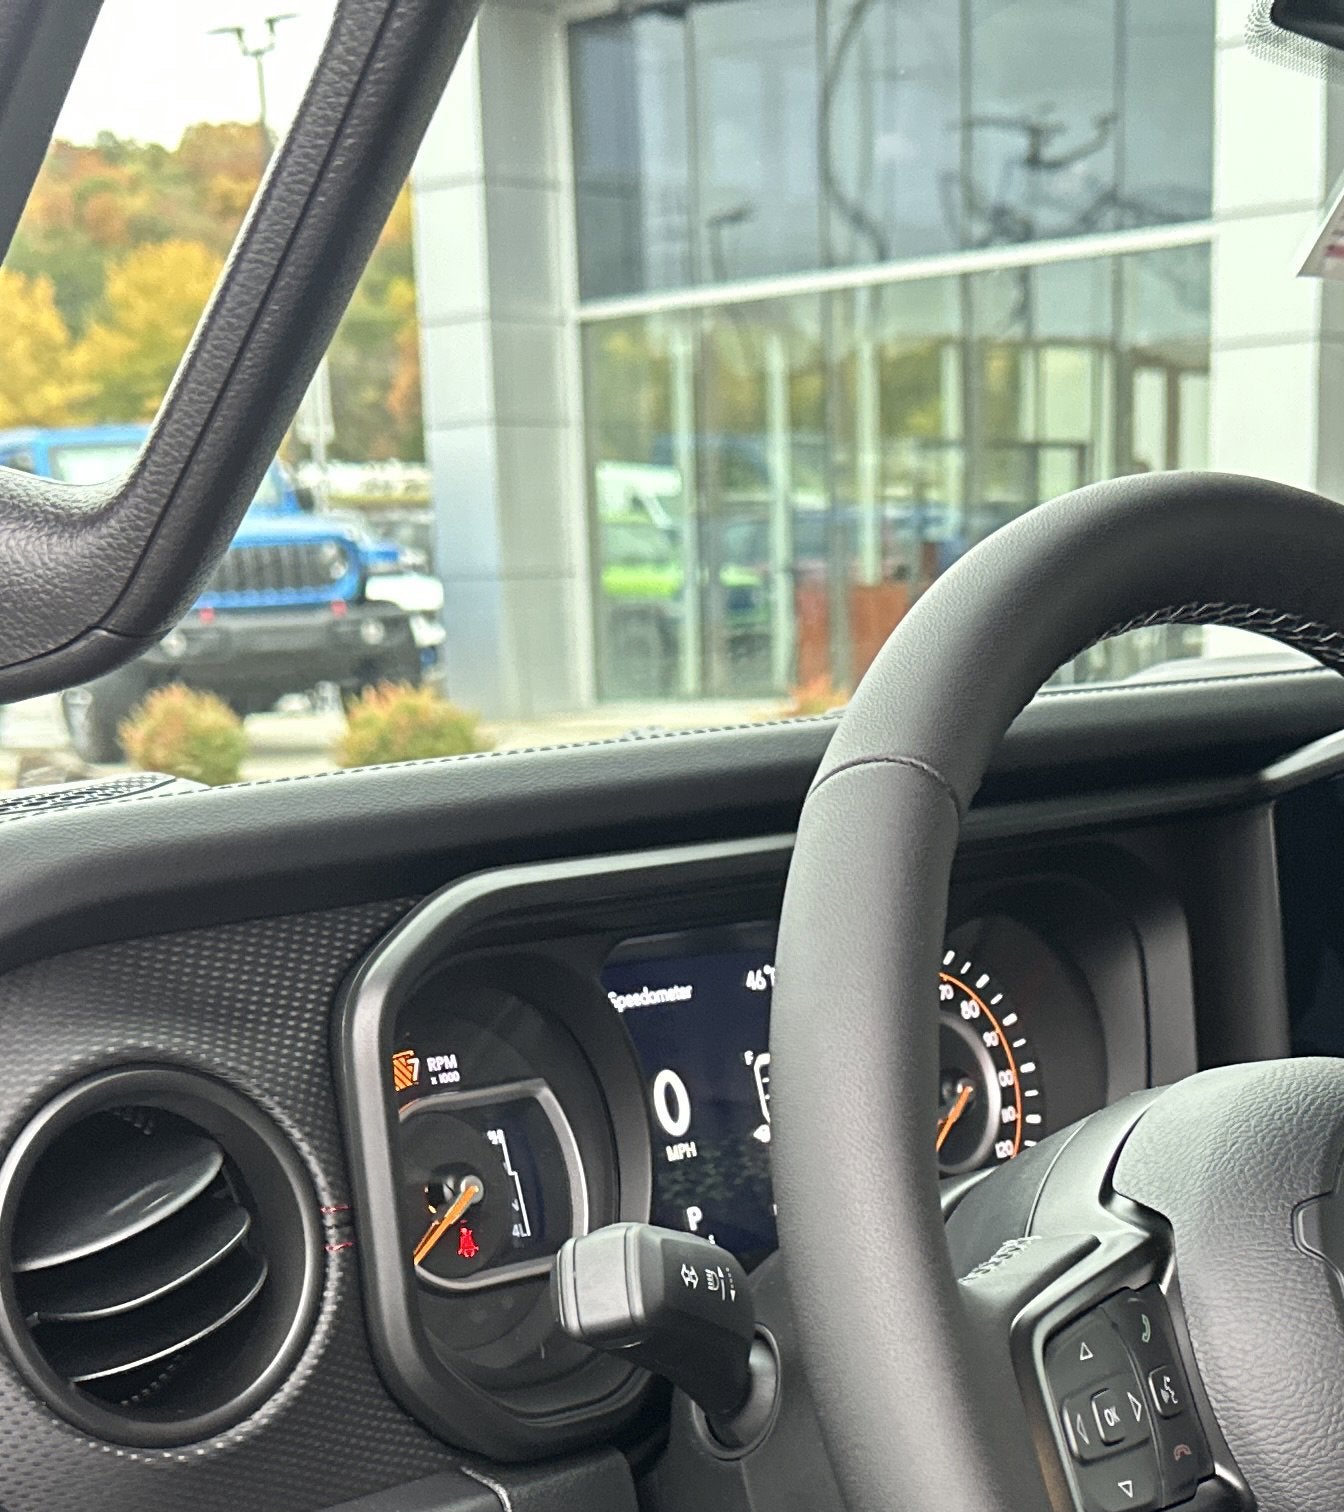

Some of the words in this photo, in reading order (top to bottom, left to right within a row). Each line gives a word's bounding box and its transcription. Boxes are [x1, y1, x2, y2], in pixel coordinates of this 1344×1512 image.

[607, 985, 693, 1013] Speedometer
[960, 999, 981, 1020] 80
[426, 1054, 458, 1072] RPM
[653, 1069, 691, 1137] 0
[665, 1141, 698, 1162] MPH
[685, 1205, 703, 1231] P
[1103, 1406, 1121, 1427] OK
